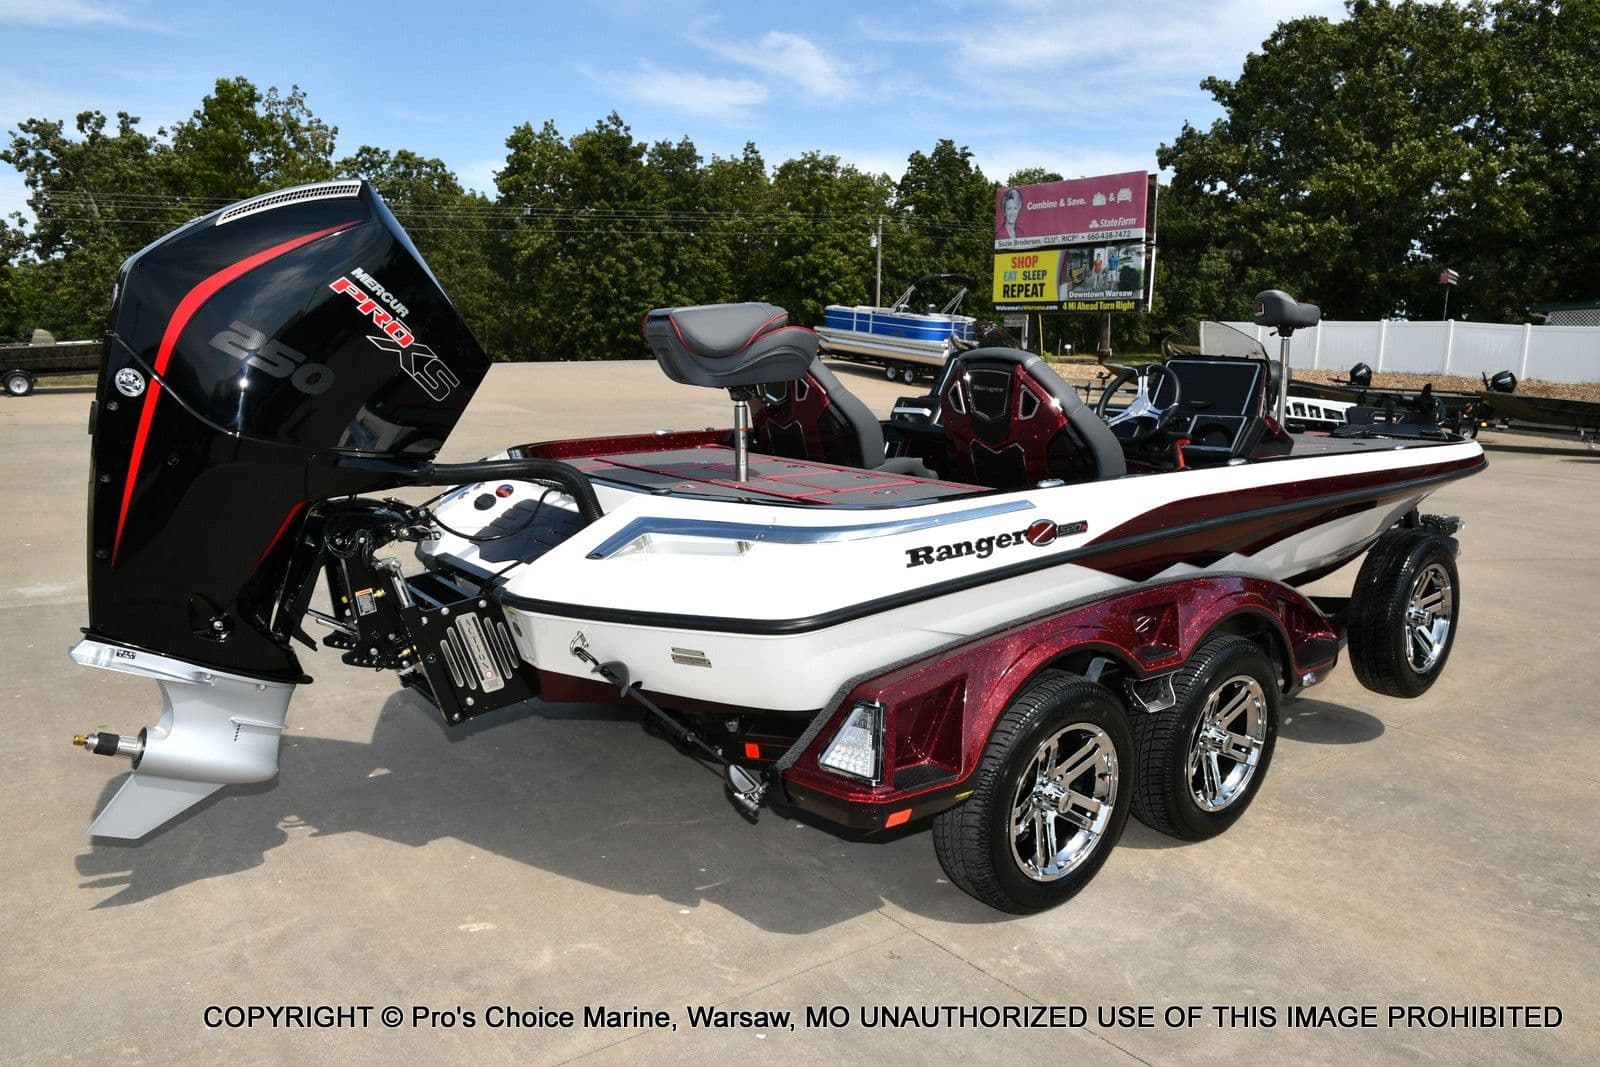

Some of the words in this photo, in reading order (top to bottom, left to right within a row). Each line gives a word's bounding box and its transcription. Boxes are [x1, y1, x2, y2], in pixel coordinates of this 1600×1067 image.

[1026, 199, 1057, 210] Combine
[1059, 198, 1065, 207] &
[1087, 230, 1131, 241] 660-438-7472
[1011, 255, 1039, 269] SHOP
[1003, 271, 1017, 281] EAT
[1022, 269, 1047, 281] SLEEP
[1003, 283, 1046, 298] REPEAT
[1069, 290, 1105, 299] Downtown
[1105, 290, 1133, 298] Warsaw
[329, 276, 415, 348] PRO
[1062, 302, 1067, 310] 4
[1068, 302, 1077, 311] Mi
[1077, 302, 1098, 311] Ahead
[1099, 302, 1115, 310] Turn
[1115, 301, 1135, 312] Right
[208, 320, 336, 394] 250
[366, 335, 460, 401] XS
[905, 528, 1029, 568] Ranger
